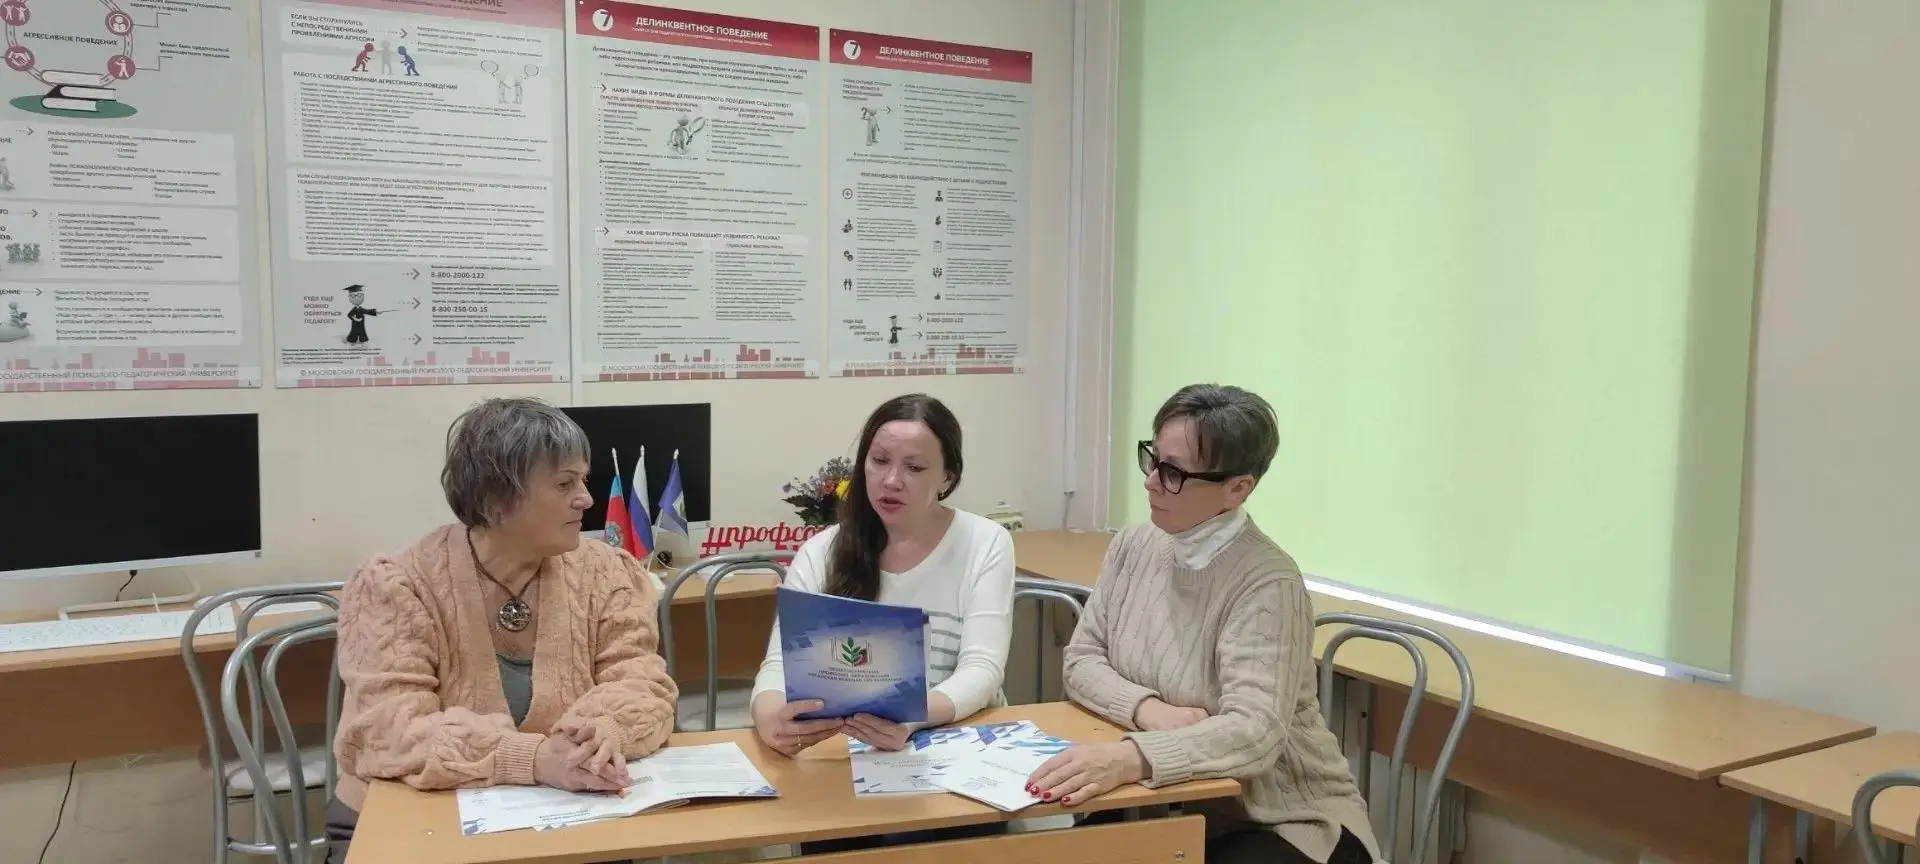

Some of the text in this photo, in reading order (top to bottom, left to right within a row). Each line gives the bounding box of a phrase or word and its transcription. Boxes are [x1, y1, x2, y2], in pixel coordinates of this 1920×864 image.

[600, 11, 610, 27] 7
[636, 16, 769, 40] ДЕЛИНКВЕНТНОЕ ПОВЕДЕНИЕ
[23, 32, 118, 46] АГРЕССИВНОЕ ПОВЕДЕНИЕ
[850, 42, 858, 56] 7
[879, 46, 944, 61] ДЕЛИНКВЕНТНОЕ
[946, 53, 989, 66] ПОВЕДЕНИЕ
[293, 71, 318, 79] РАБОТА
[378, 78, 422, 87] АГРЕССИВНОГО
[72, 369, 187, 379] ПСИХОЛОГО-ПЕДАГОГИЧЕСКИЙ
[189, 369, 238, 378] УНИВЕРСИТЕТ
[700, 521, 825, 558] #профсо
